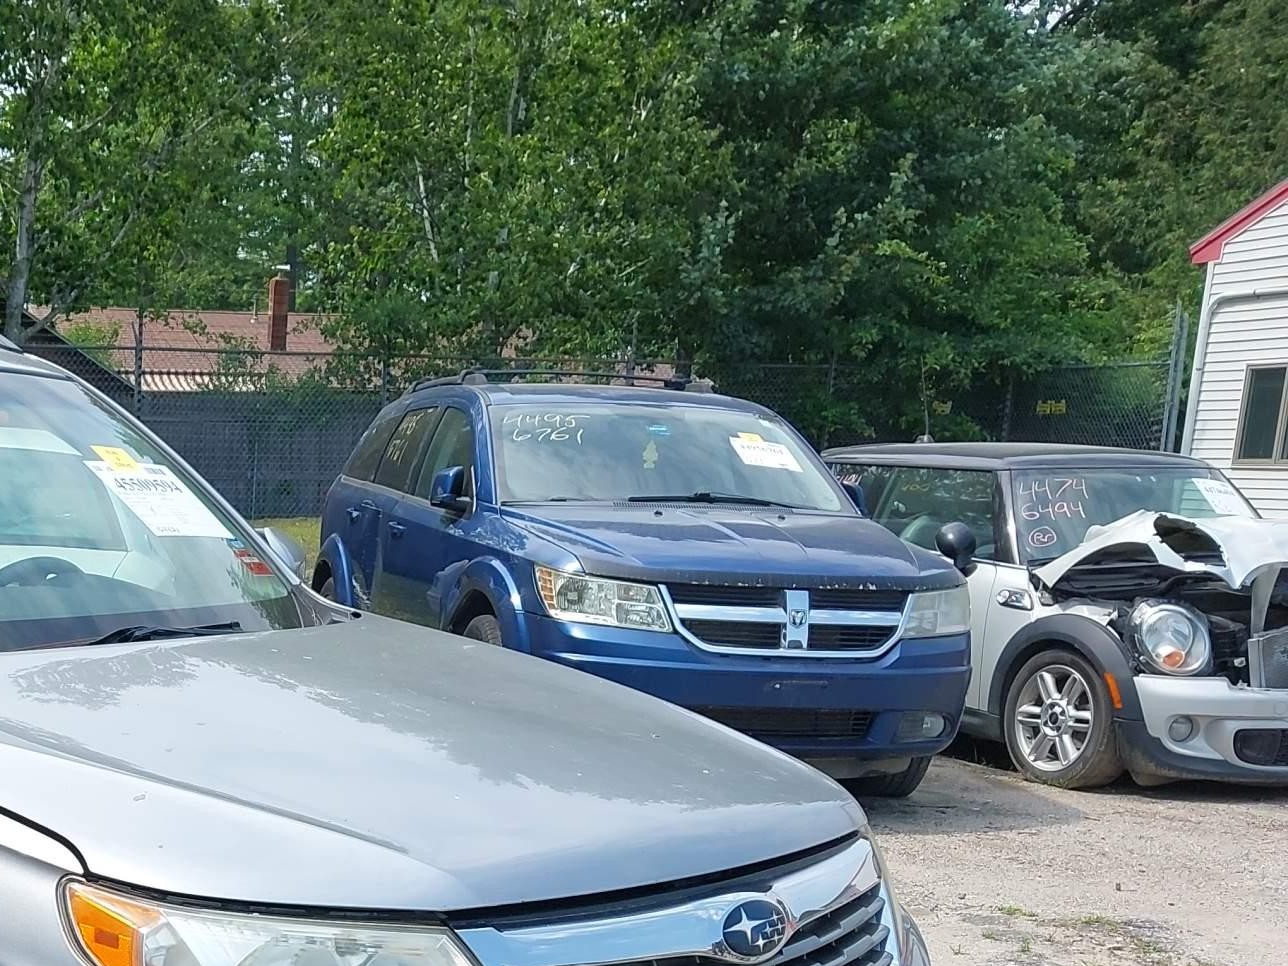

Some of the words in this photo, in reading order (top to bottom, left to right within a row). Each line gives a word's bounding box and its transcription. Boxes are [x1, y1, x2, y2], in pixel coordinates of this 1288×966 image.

[503, 413, 591, 428] 4495
[512, 427, 584, 445] 6761
[1019, 478, 1089, 501] 4474
[1021, 500, 1086, 520] 6494
